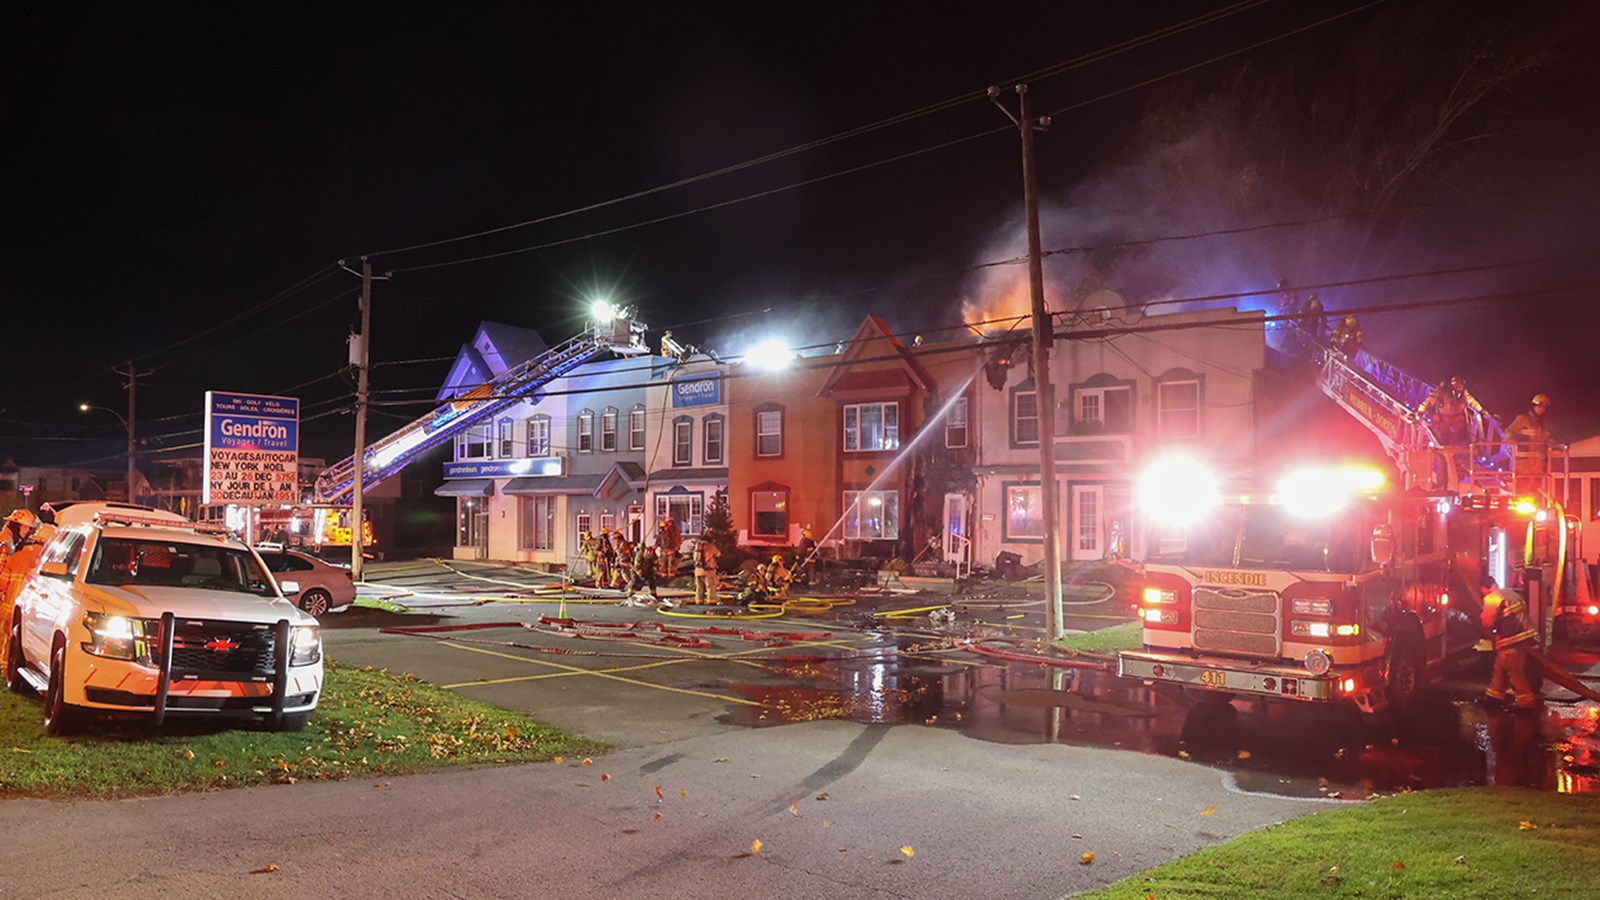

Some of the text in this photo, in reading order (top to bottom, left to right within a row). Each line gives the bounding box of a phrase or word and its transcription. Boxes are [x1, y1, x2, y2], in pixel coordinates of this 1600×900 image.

[678, 380, 714, 394] Gendron
[221, 419, 287, 439] Gendron
[222, 437, 255, 446] Voyages
[264, 438, 287, 447] Travel
[211, 461, 285, 472] NEW YORK NOEL
[211, 472, 223, 480] 23
[225, 472, 238, 480] AU
[241, 472, 253, 481] 26
[255, 473, 272, 481] DEC
[211, 481, 292, 491] NY JOUR DE L AN
[1205, 571, 1266, 586] INCENDIE
[1201, 670, 1226, 686] 411
